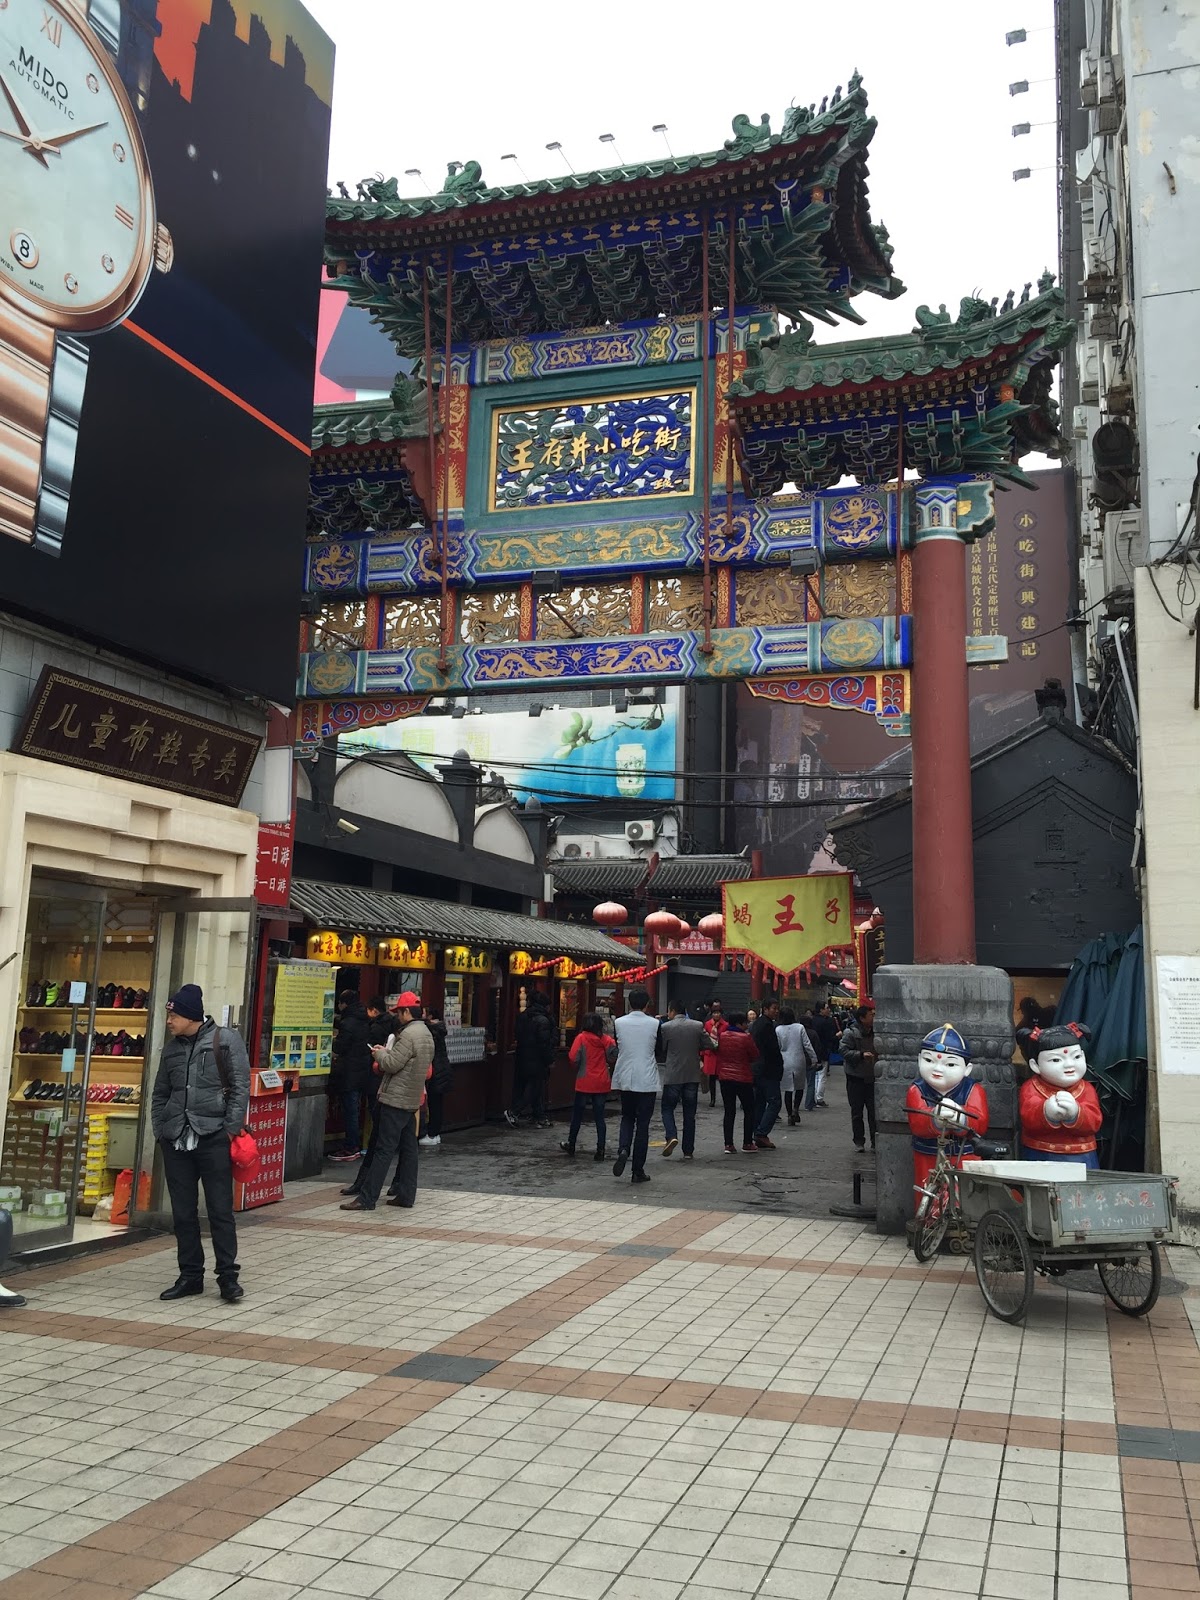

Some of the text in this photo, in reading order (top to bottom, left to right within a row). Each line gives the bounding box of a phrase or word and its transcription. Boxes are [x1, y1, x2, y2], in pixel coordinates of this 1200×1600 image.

[8, 59, 75, 121] AUTOMATIC
[19, 46, 69, 100] MIDO
[20, 239, 30, 259] 8
[29, 279, 45, 291] MADE
[507, 426, 682, 473] 王府井小吃街
[1018, 513, 1037, 657] 小吃街興建記
[49, 703, 237, 784] 儿童布鞋专卖
[258, 1151, 283, 1165] 播电视塔
